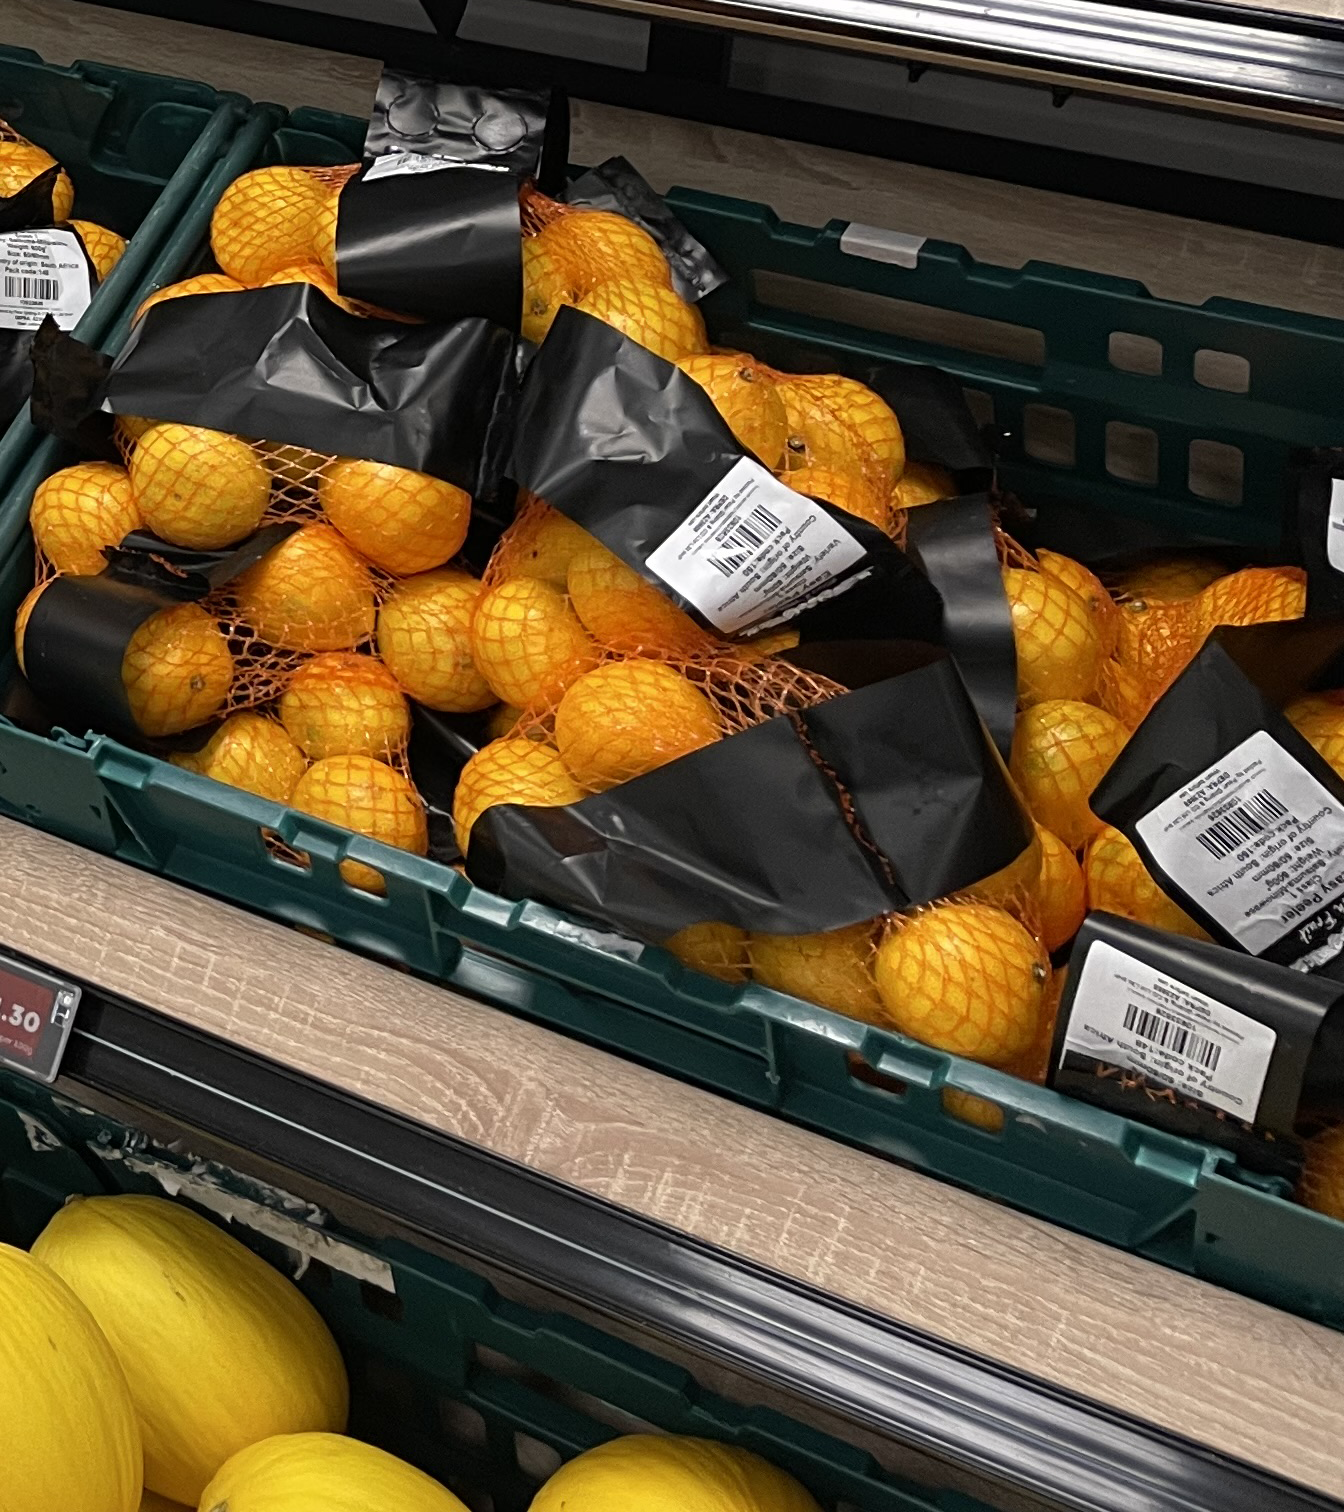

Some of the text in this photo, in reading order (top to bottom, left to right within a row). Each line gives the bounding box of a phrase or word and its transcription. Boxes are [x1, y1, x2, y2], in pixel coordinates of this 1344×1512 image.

[11, 258, 19, 266] of
[1274, 815, 1300, 833] Pack
[1206, 805, 1333, 897] Country of origin: South Africa
[1293, 836, 1315, 852] Size:
[1288, 847, 1325, 873] Weight:
[1295, 874, 1323, 896] Class
[1280, 873, 1344, 924] asy Peeler
[1298, 910, 1337, 944] Fruit
[1083, 1023, 1244, 1106] Country of origin: South Africa
[1187, 1062, 1213, 1083] Pack
